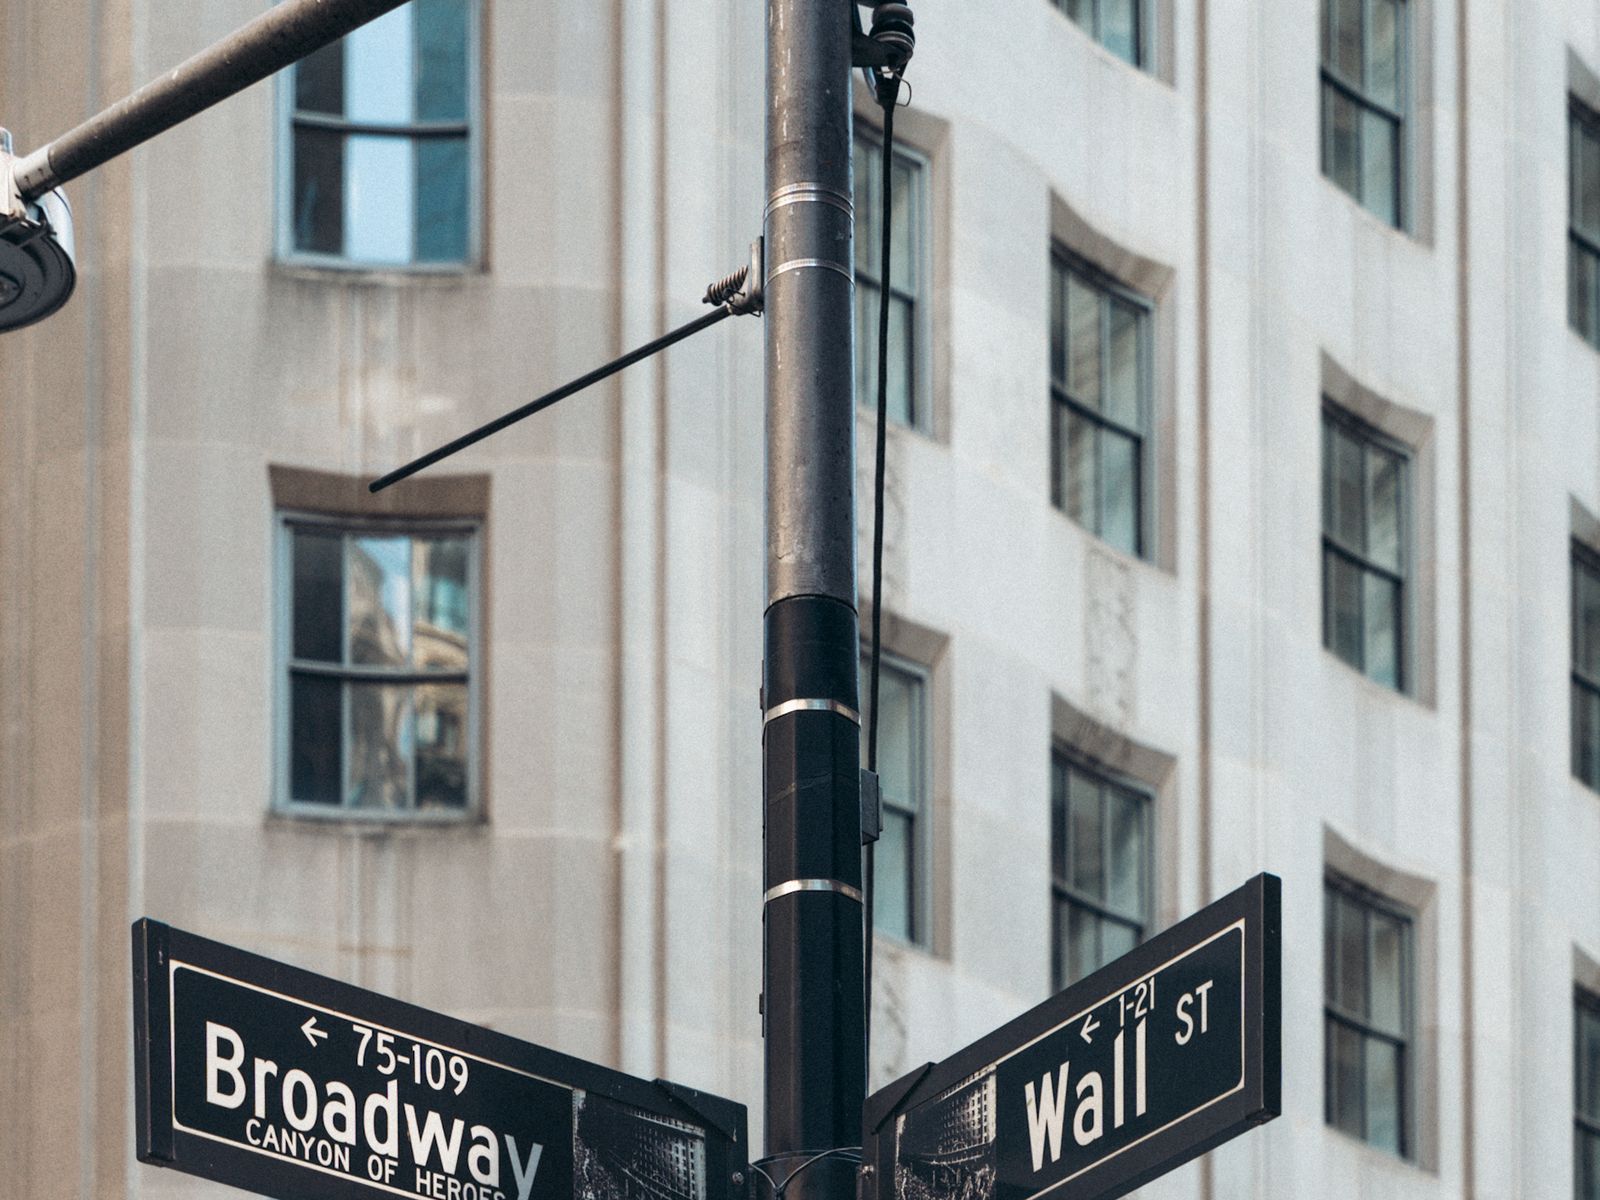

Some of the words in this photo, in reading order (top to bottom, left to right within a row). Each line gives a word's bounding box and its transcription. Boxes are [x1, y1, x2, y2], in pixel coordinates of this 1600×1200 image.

[1118, 976, 1156, 1028] 1-21
[352, 1024, 470, 1097] 75-109
[1024, 1016, 1147, 1173] Wall
[1174, 979, 1214, 1046] ST
[245, 1118, 351, 1173] CANYON
[367, 1154, 399, 1185] OF
